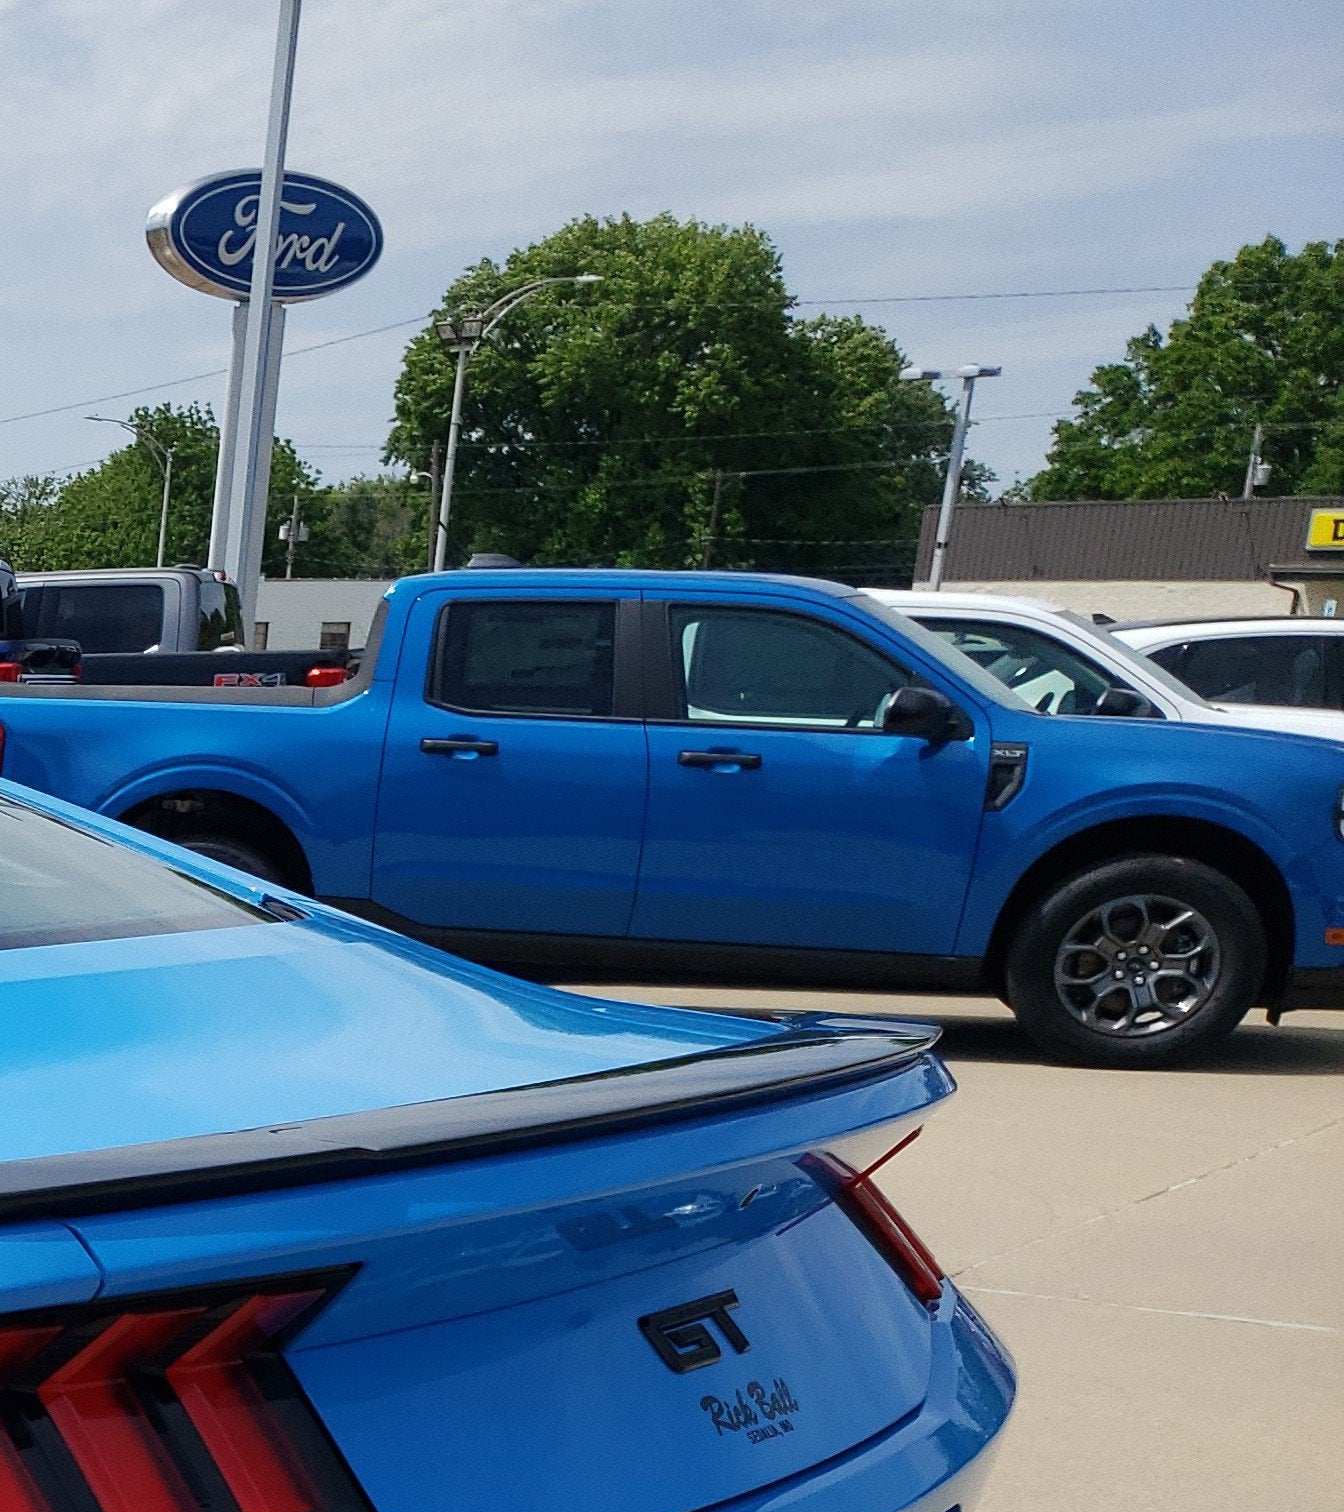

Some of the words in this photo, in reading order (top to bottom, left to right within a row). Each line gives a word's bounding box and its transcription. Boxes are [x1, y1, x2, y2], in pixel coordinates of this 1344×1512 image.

[218, 195, 346, 273] Frd
[992, 748, 1026, 758] XLT
[636, 1288, 751, 1374] GT
[700, 1388, 759, 1437] Rick
[747, 1377, 800, 1420] Ball
